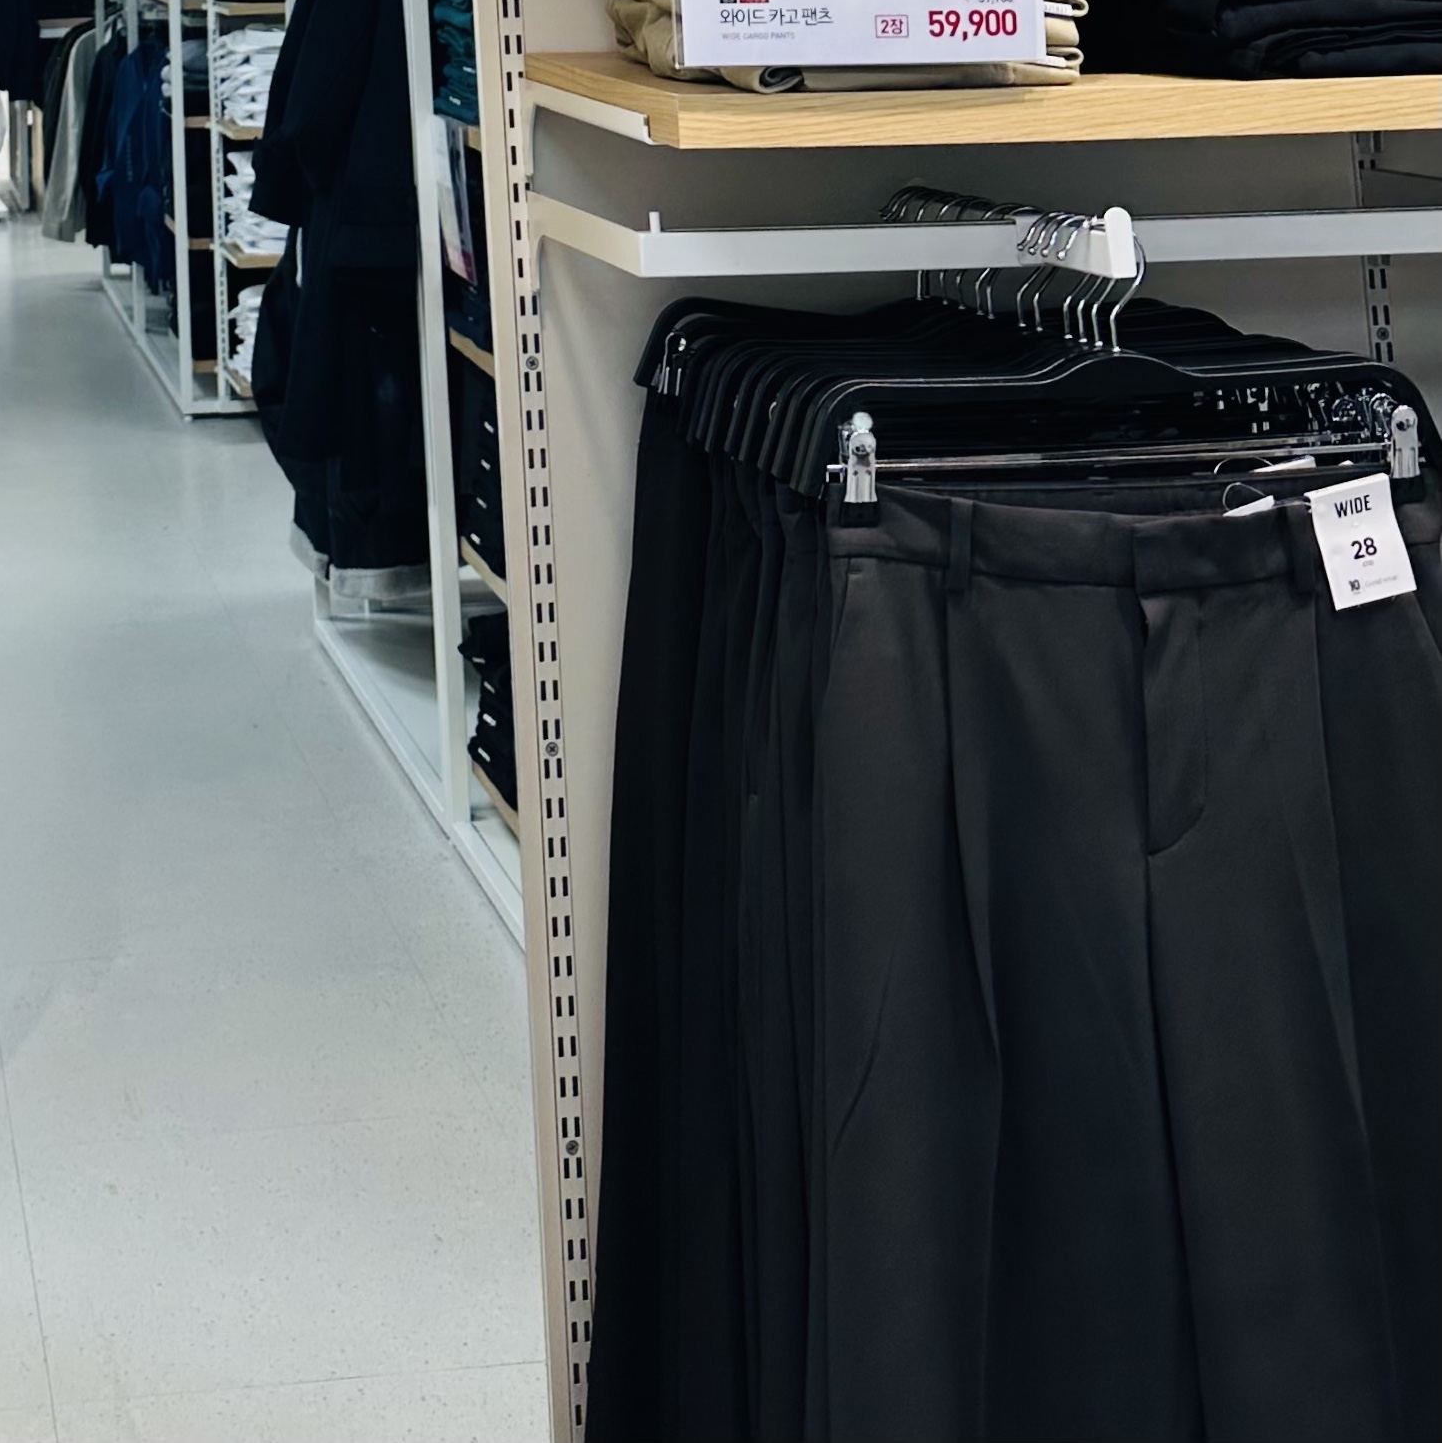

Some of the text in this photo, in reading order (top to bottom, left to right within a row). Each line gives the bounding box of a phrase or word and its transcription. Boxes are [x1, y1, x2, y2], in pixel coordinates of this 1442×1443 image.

[720, 7, 834, 26] 와이드 카고 팬츠
[880, 19, 904, 34] 2장
[928, 9, 1018, 41] 59,900
[1334, 494, 1372, 518] WIDE
[1351, 537, 1377, 560] 28
